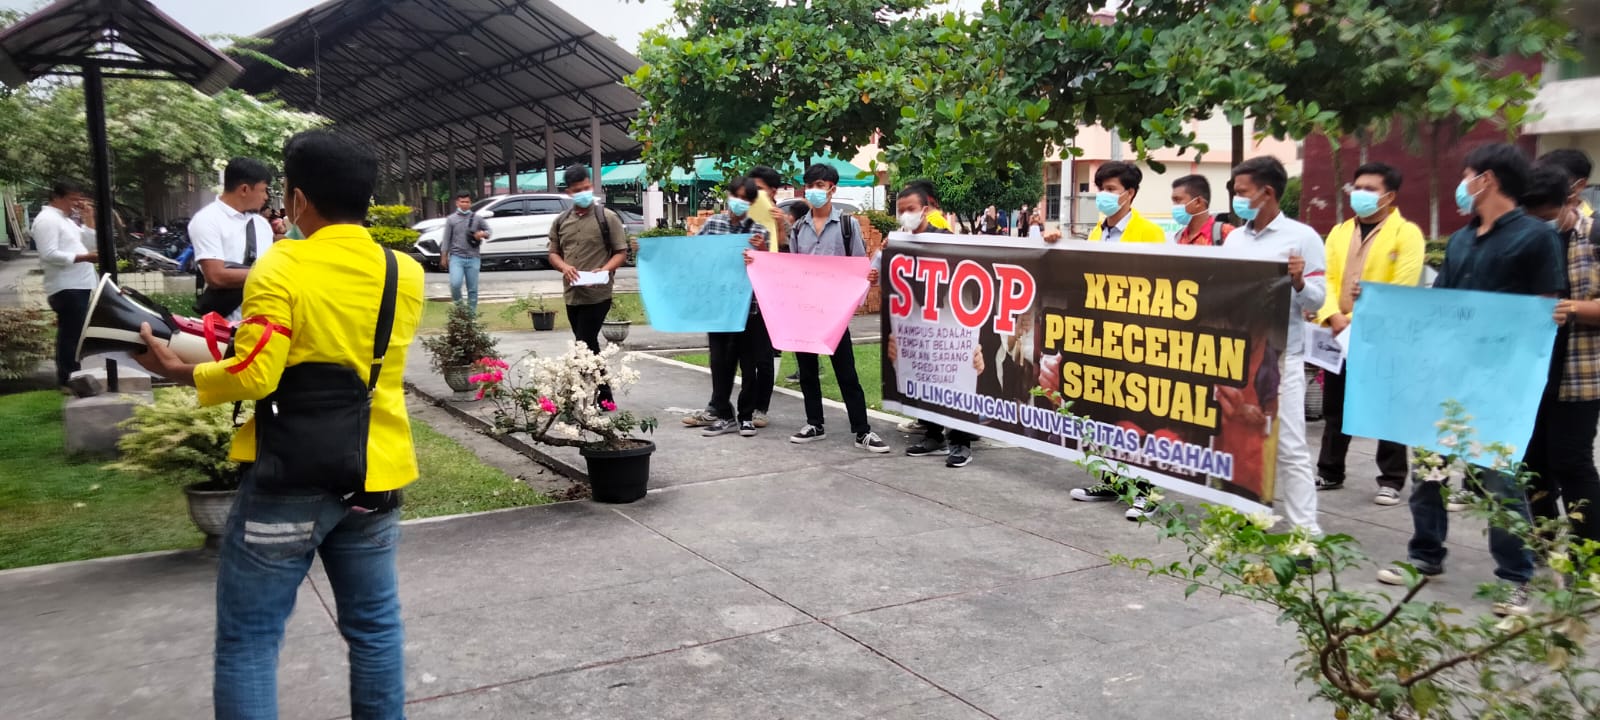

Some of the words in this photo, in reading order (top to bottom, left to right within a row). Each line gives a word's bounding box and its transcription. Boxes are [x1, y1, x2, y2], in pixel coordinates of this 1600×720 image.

[889, 254, 1036, 335] STOP
[1084, 273, 1199, 321] KERAS
[896, 336, 930, 350] TEMPAT
[932, 340, 972, 351] BELAJAR
[897, 324, 934, 338] KAMPUS
[936, 327, 972, 338] ADALAH
[901, 348, 930, 361] BUKAN
[932, 351, 969, 362] SARANG
[1045, 313, 1246, 381] PELECEHAN
[911, 361, 958, 373] PREDATOR
[1063, 361, 1217, 428] SEKSUAL
[906, 380, 918, 397] DI
[922, 383, 1017, 422] LINGKUNGAN
[1021, 407, 1138, 452] UNIVERSITAS
[1144, 437, 1232, 478] ASAHAN
